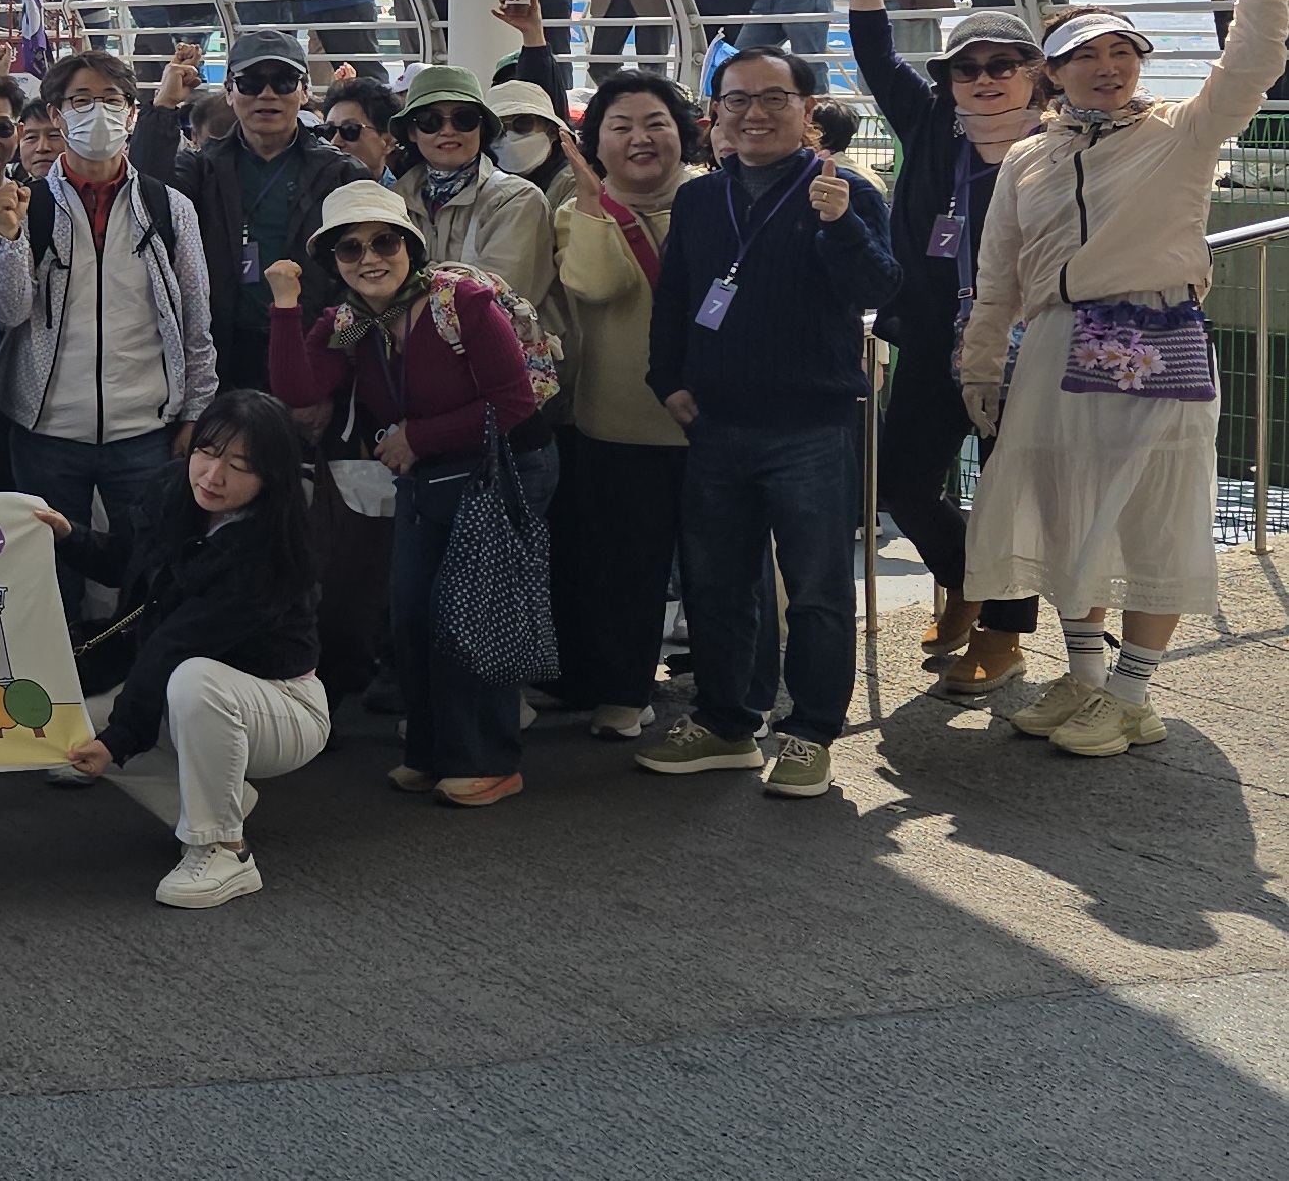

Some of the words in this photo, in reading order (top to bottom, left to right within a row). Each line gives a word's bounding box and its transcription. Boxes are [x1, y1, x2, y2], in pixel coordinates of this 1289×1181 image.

[939, 233, 954, 247] 7
[241, 260, 253, 274] 7
[708, 299, 723, 314] 7
